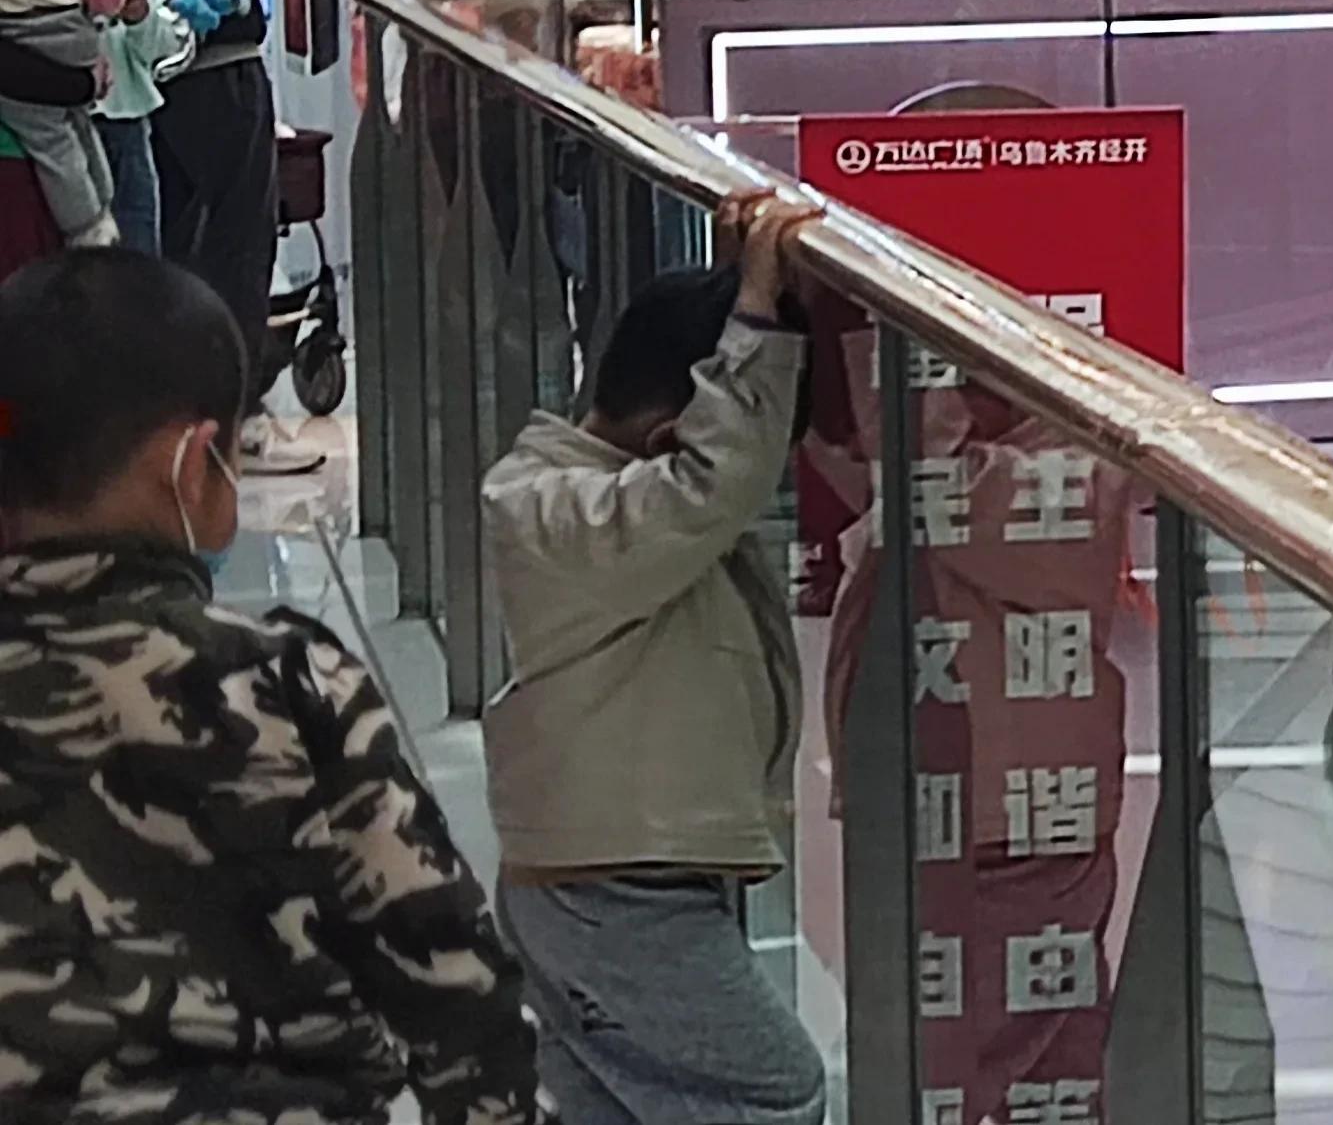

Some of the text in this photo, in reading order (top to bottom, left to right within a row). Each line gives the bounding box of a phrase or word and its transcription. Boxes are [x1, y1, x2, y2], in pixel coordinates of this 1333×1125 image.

[874, 138, 1147, 166] 万达广场 乌鲁木齐经开
